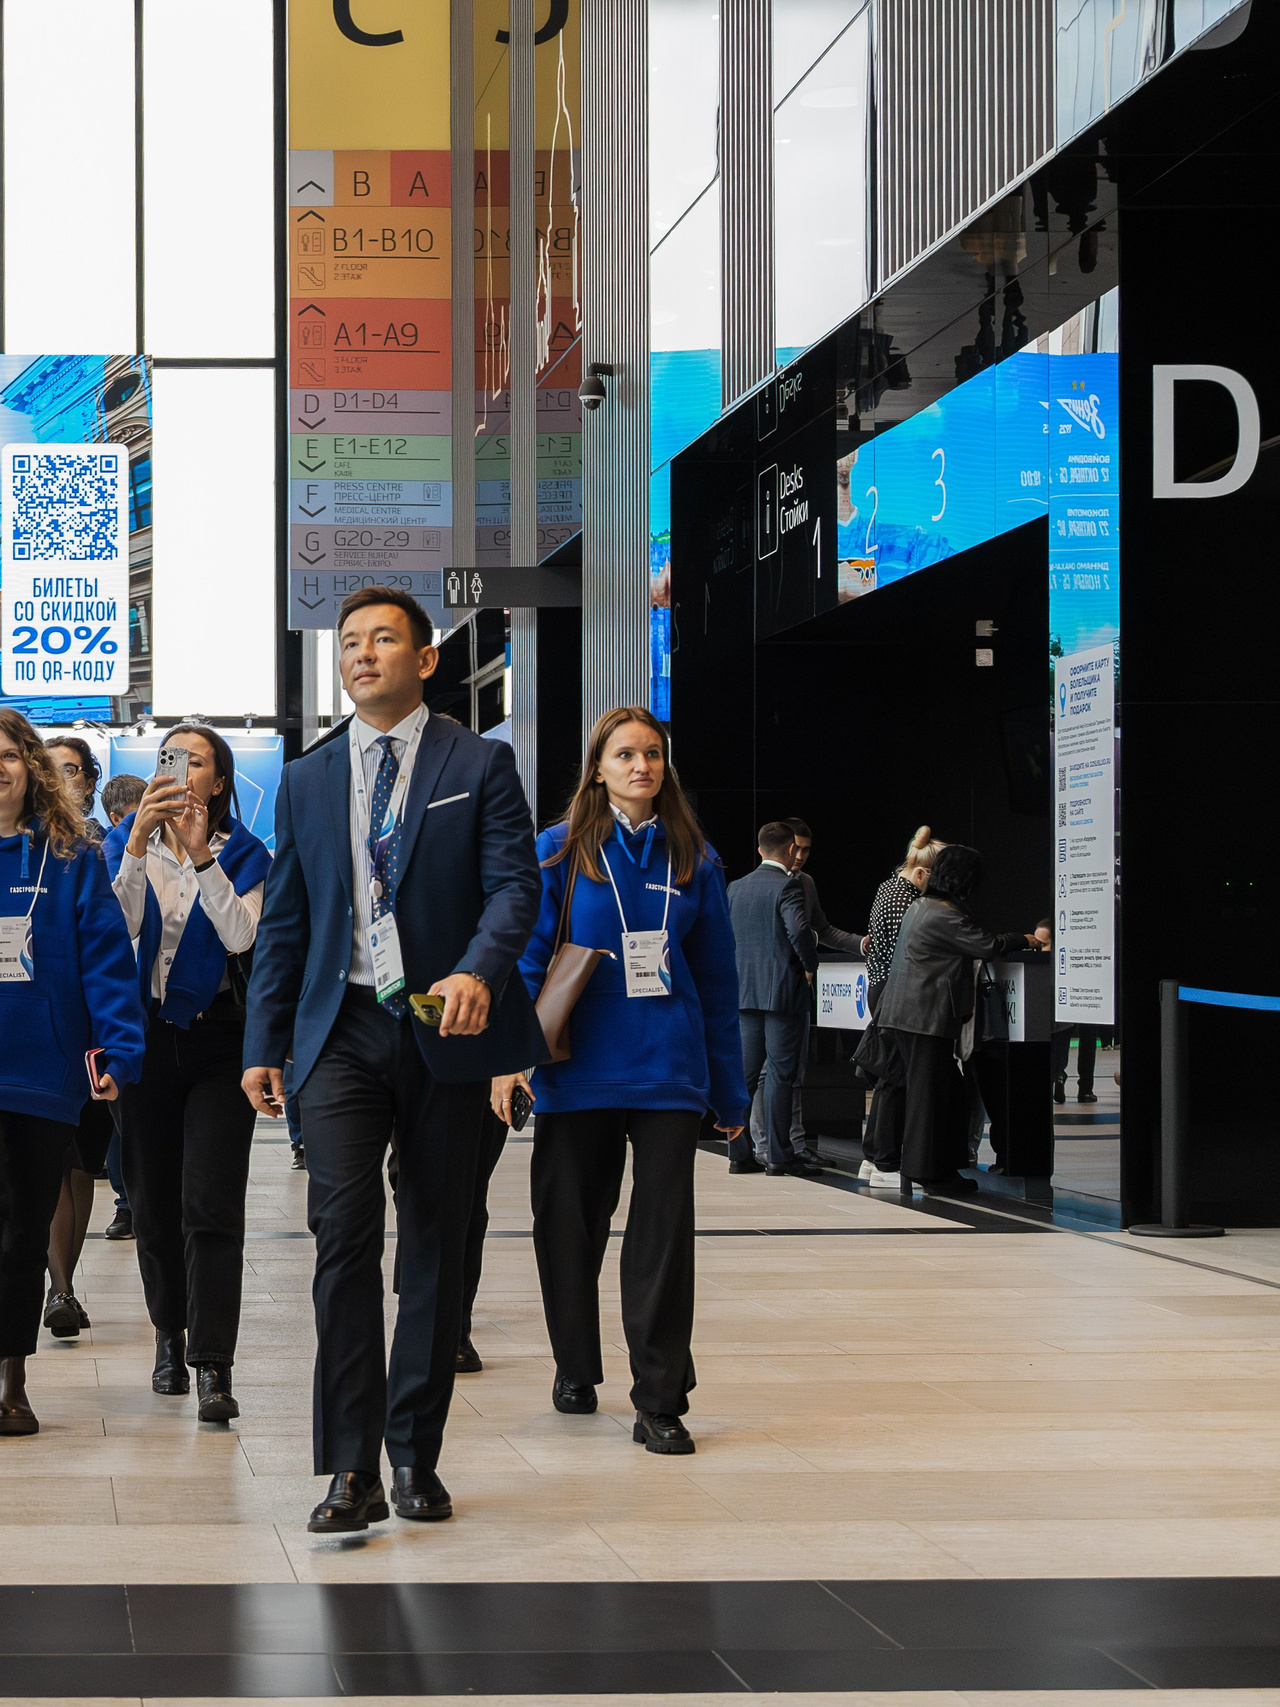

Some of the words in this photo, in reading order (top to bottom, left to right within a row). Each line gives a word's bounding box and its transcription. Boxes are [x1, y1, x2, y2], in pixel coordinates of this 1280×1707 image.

[353, 170, 371, 197] B
[409, 170, 429, 197] A
[333, 228, 434, 253] B1-B10
[334, 322, 419, 347] A1-A9
[304, 394, 320, 414] D
[334, 392, 399, 410] D1-D4
[1153, 364, 1261, 499] D
[306, 439, 319, 459] E
[334, 438, 408, 455] E1-E12
[334, 482, 365, 491] PRESS
[367, 482, 403, 492] CENTRE
[780, 464, 803, 499] Desks
[931, 448, 946, 522] 3
[306, 484, 319, 504] F
[334, 492, 401, 503] ПРЕСС-ЦЕНТР
[334, 506, 369, 515] MEDICAL
[371, 507, 401, 515] CENTRE
[334, 515, 398, 525] МЕДИЦИНСКИЙ
[400, 517, 427, 526] ЦЕНТР
[780, 498, 809, 534] Стойки
[866, 486, 879, 554] 2
[305, 531, 319, 551] G
[334, 530, 409, 547] G20-29
[812, 517, 821, 578] 1
[368, 552, 398, 560] BUREAU
[33, 578, 98, 598] БИЛЕТЫ
[304, 576, 319, 595] H
[334, 576, 412, 591] H20-29
[14, 601, 34, 621] СО
[41, 597, 117, 623] СКИДКОЙ
[12, 626, 118, 654] 20%
[15, 660, 36, 681] ПО
[42, 660, 115, 683] QR-КОДУ
[1094, 657, 1110, 670] КАРТУ
[1070, 673, 1101, 690] БОЛЕЛЬЩИКА
[1070, 702, 1092, 716] ПОДАРОК
[631, 986, 664, 994] SPECIALIST
[822, 1000, 833, 1014] 2024
